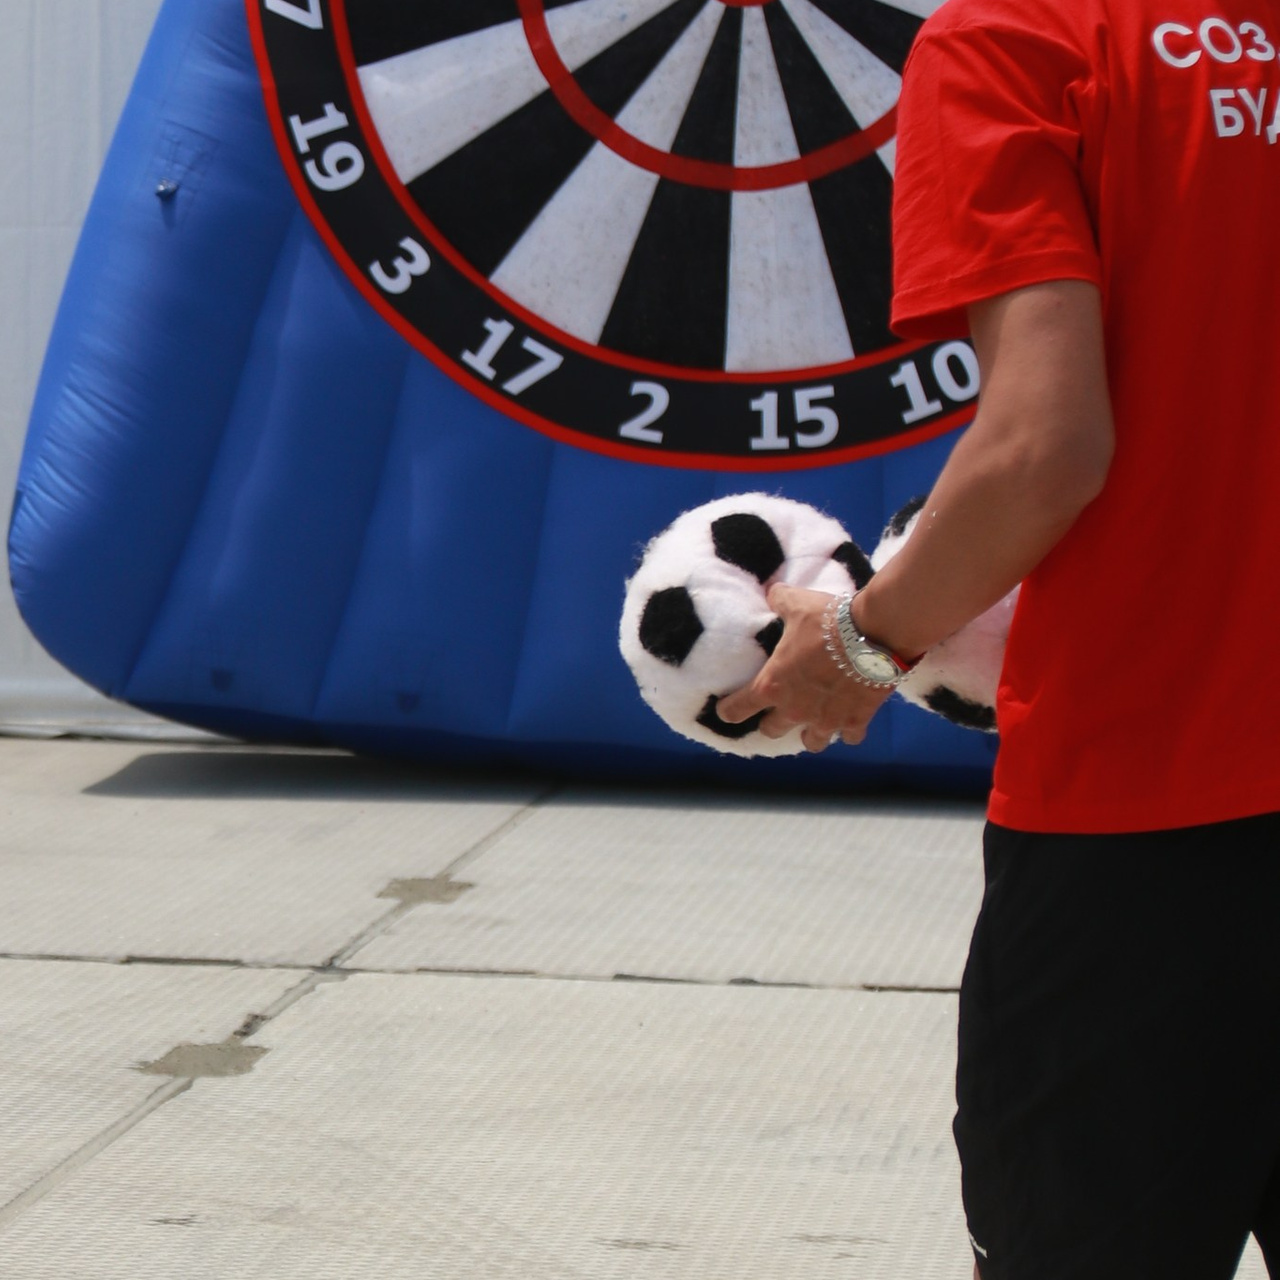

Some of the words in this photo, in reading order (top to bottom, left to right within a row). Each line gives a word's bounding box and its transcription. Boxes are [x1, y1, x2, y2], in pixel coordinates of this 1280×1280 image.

[1151, 16, 1280, 69] СОЗ
[288, 102, 366, 192] 19
[369, 236, 432, 294] 3
[461, 317, 565, 396] 17
[889, 340, 981, 424] 10
[619, 381, 671, 444] 2
[750, 384, 840, 450] 15
